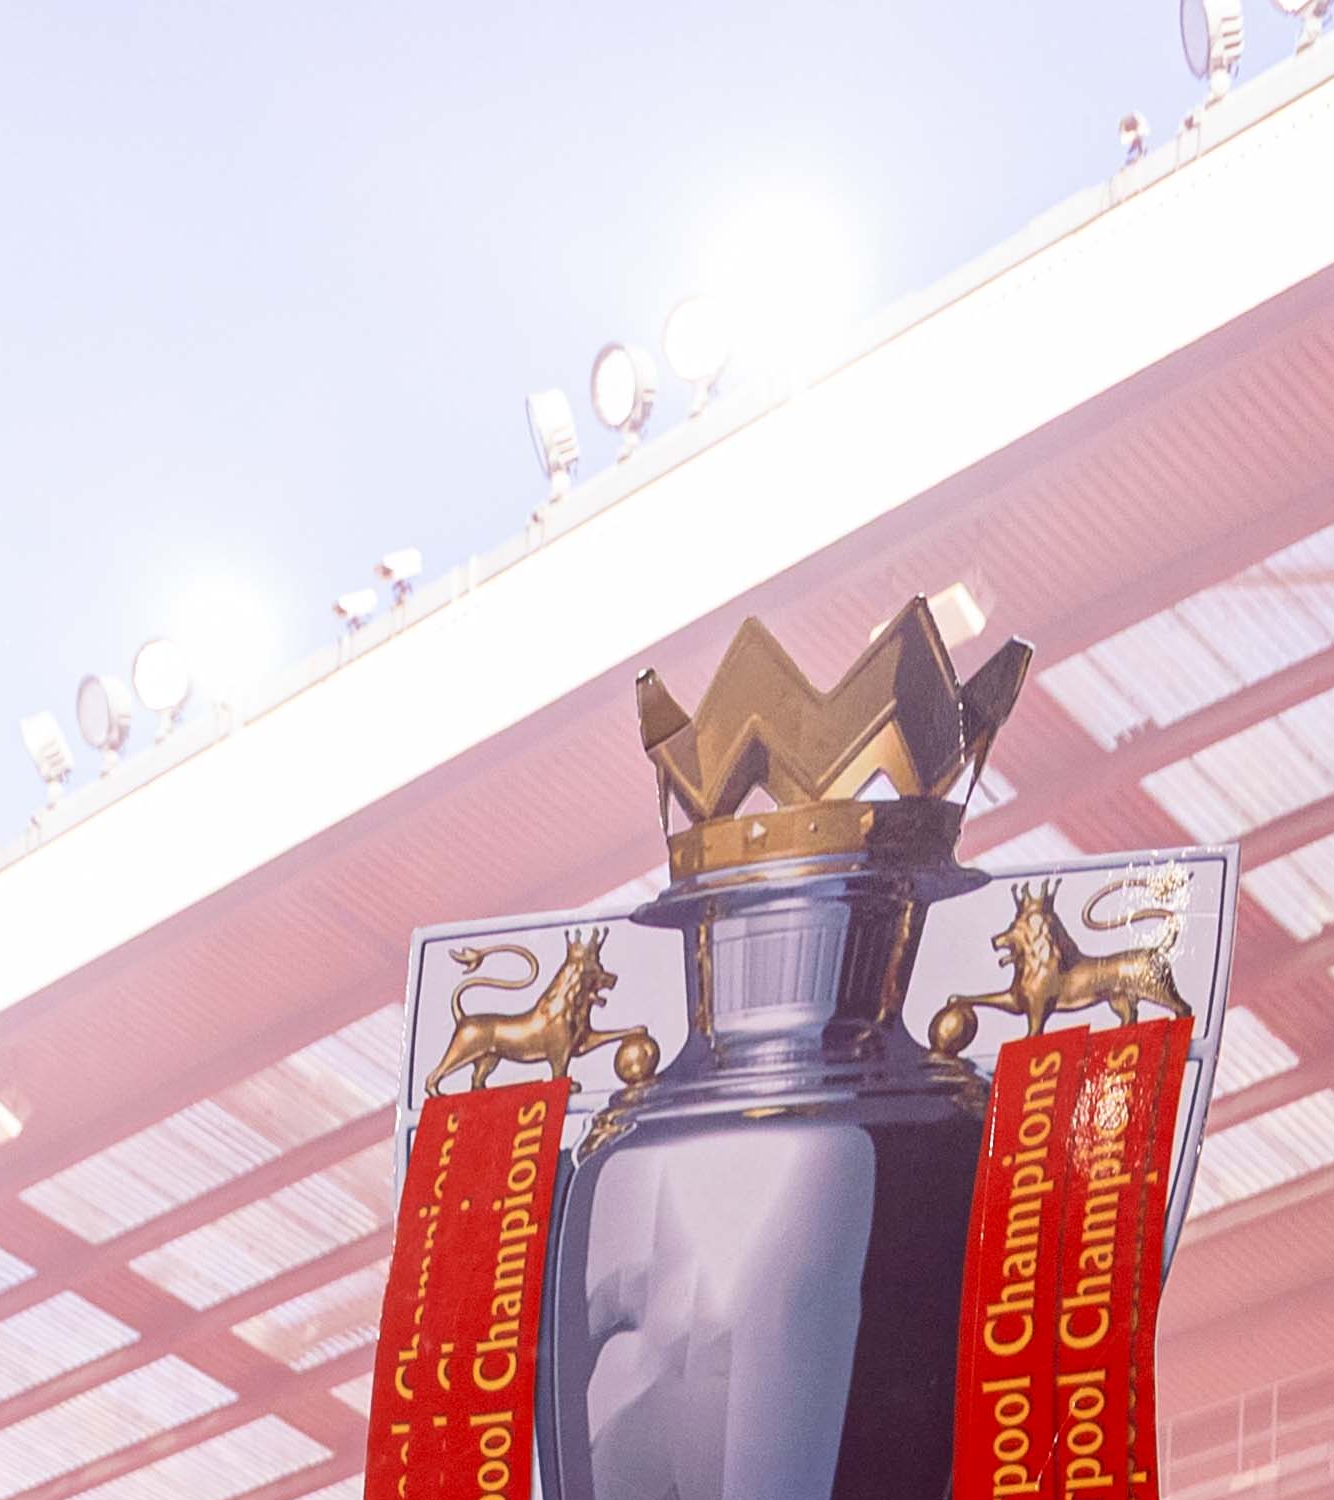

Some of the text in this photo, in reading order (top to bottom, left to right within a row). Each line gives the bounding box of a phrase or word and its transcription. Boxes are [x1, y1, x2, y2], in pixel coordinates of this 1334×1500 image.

[472, 1100, 547, 1391] Champions
[983, 1050, 1061, 1356] Champions
[1058, 1043, 1140, 1350] Champions
